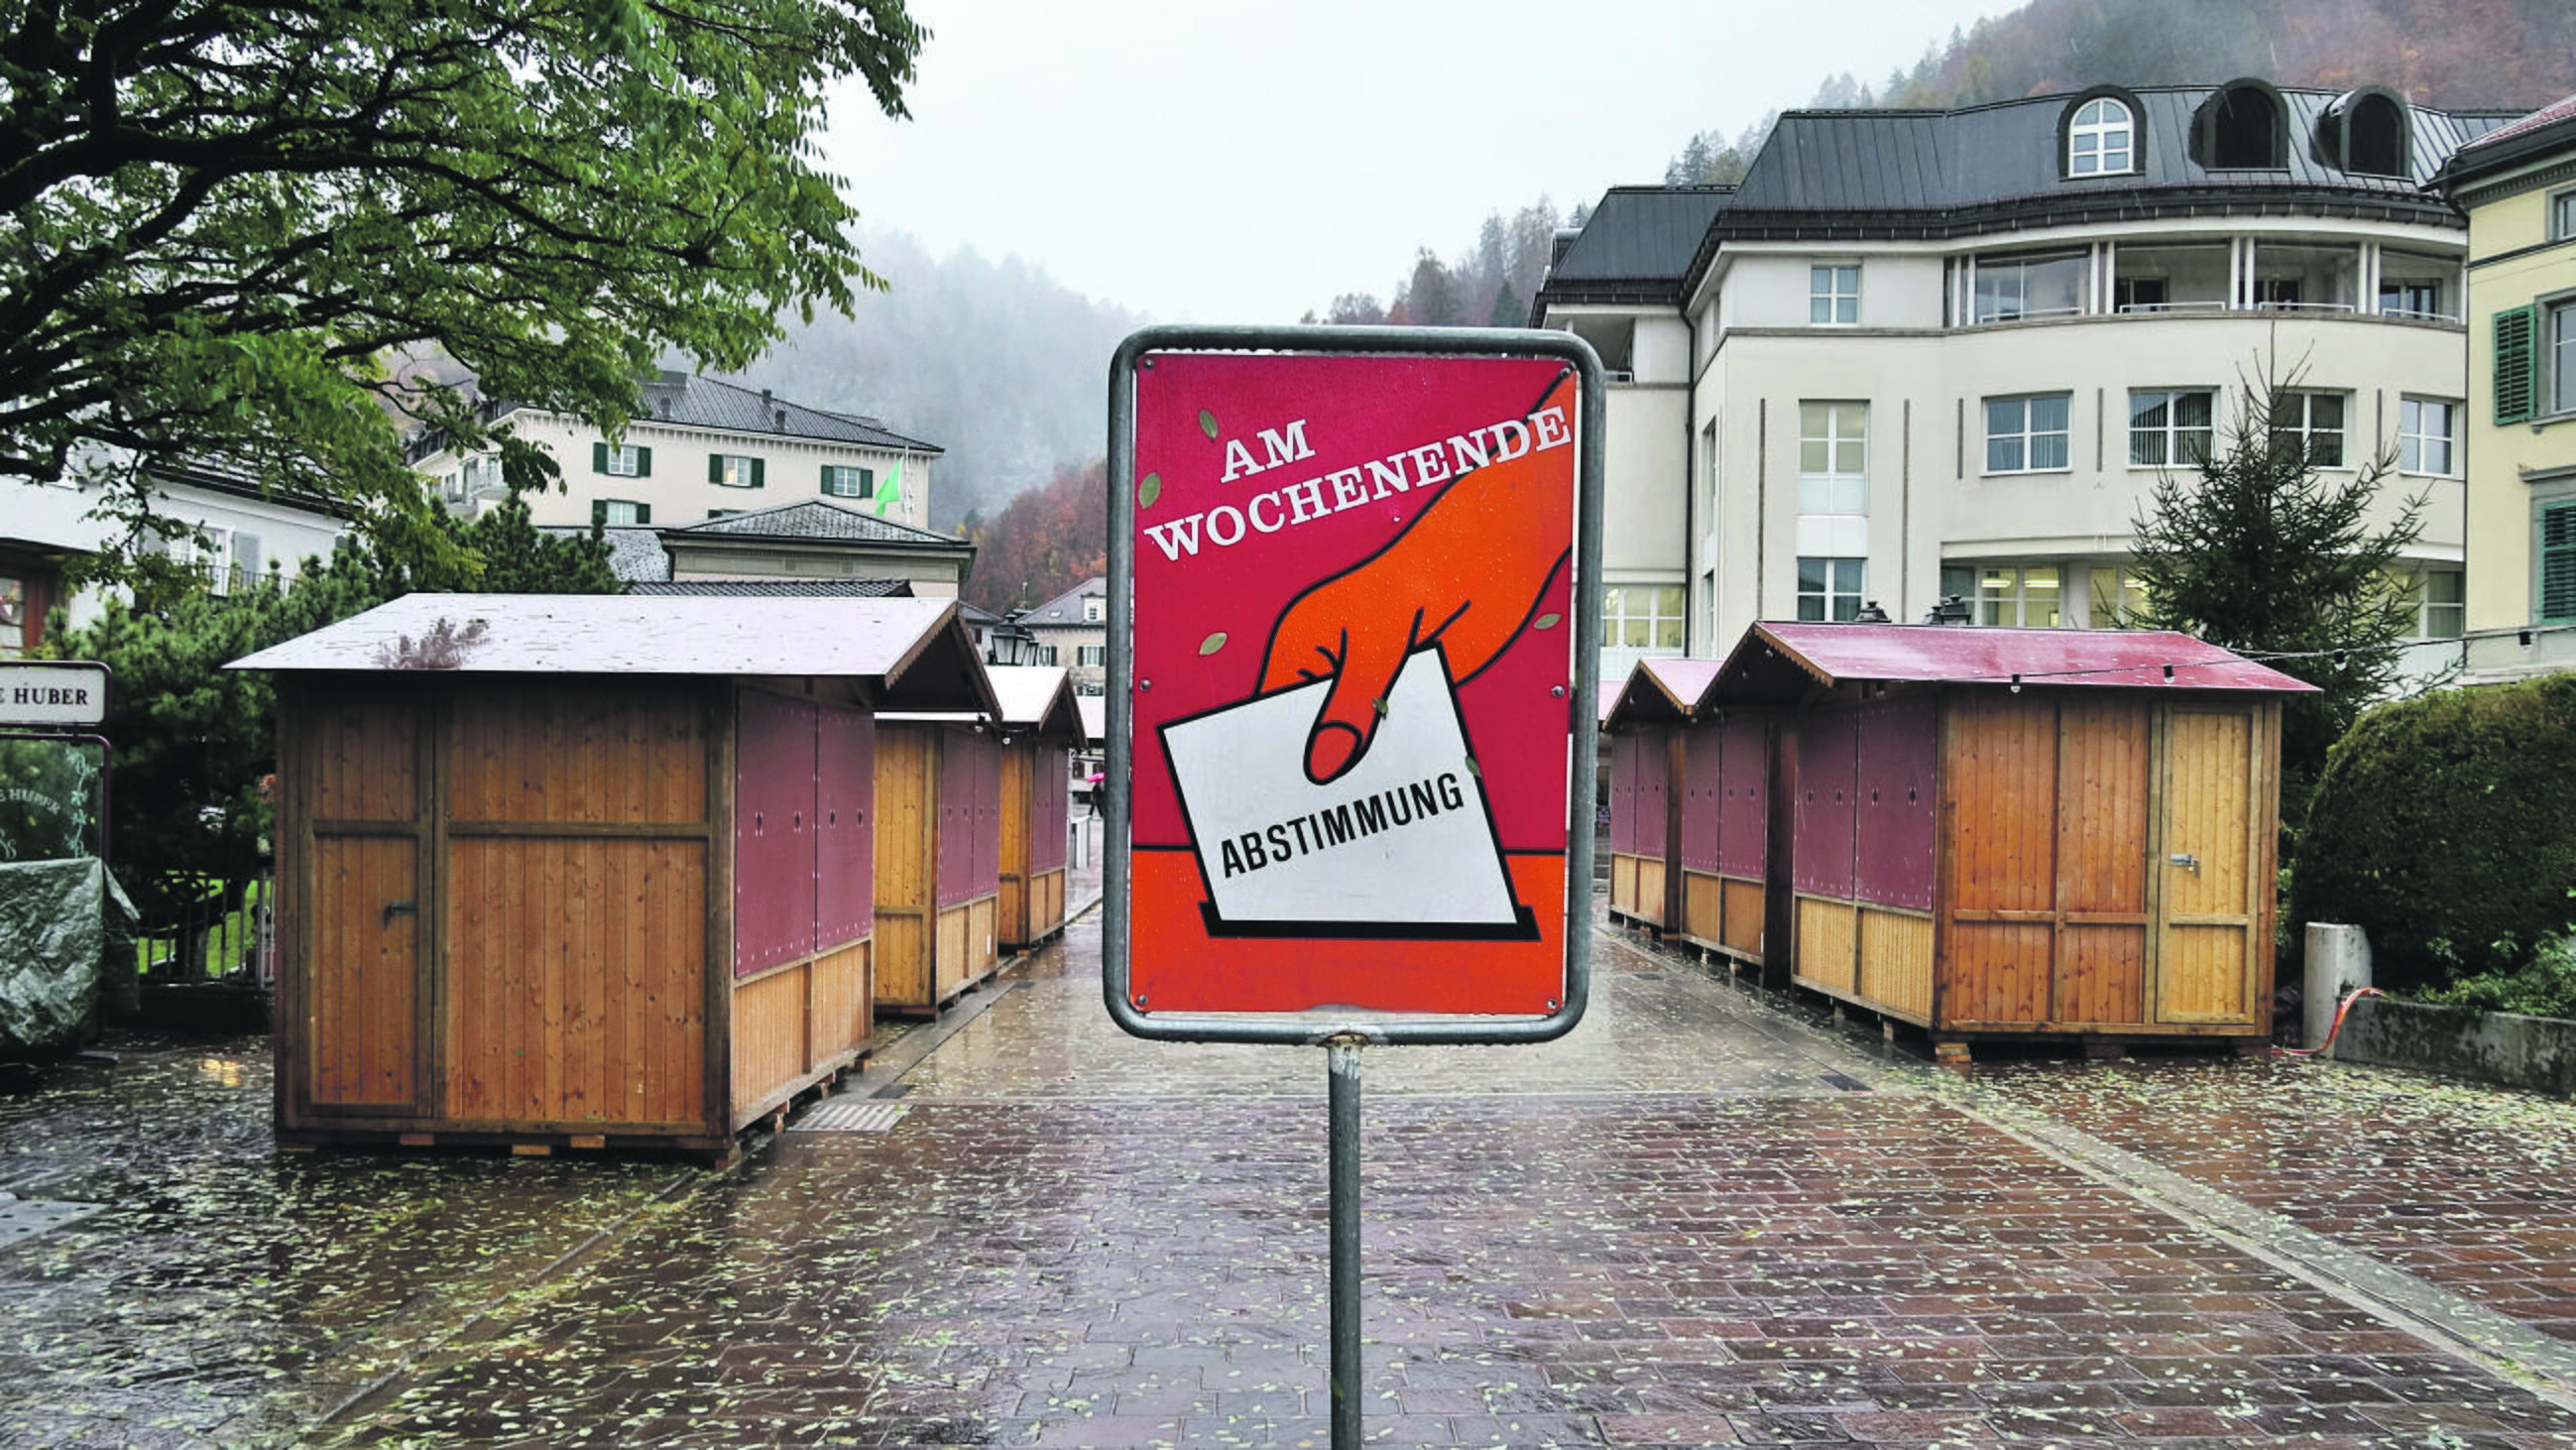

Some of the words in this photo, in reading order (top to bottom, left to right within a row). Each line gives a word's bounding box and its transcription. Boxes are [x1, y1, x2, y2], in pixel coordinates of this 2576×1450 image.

[1143, 405, 1573, 562] WOCHENENDE
[1220, 418, 1317, 484] AM
[14, 687, 88, 705] HUBER
[1220, 772, 1464, 879] ABSTIMMUNG
